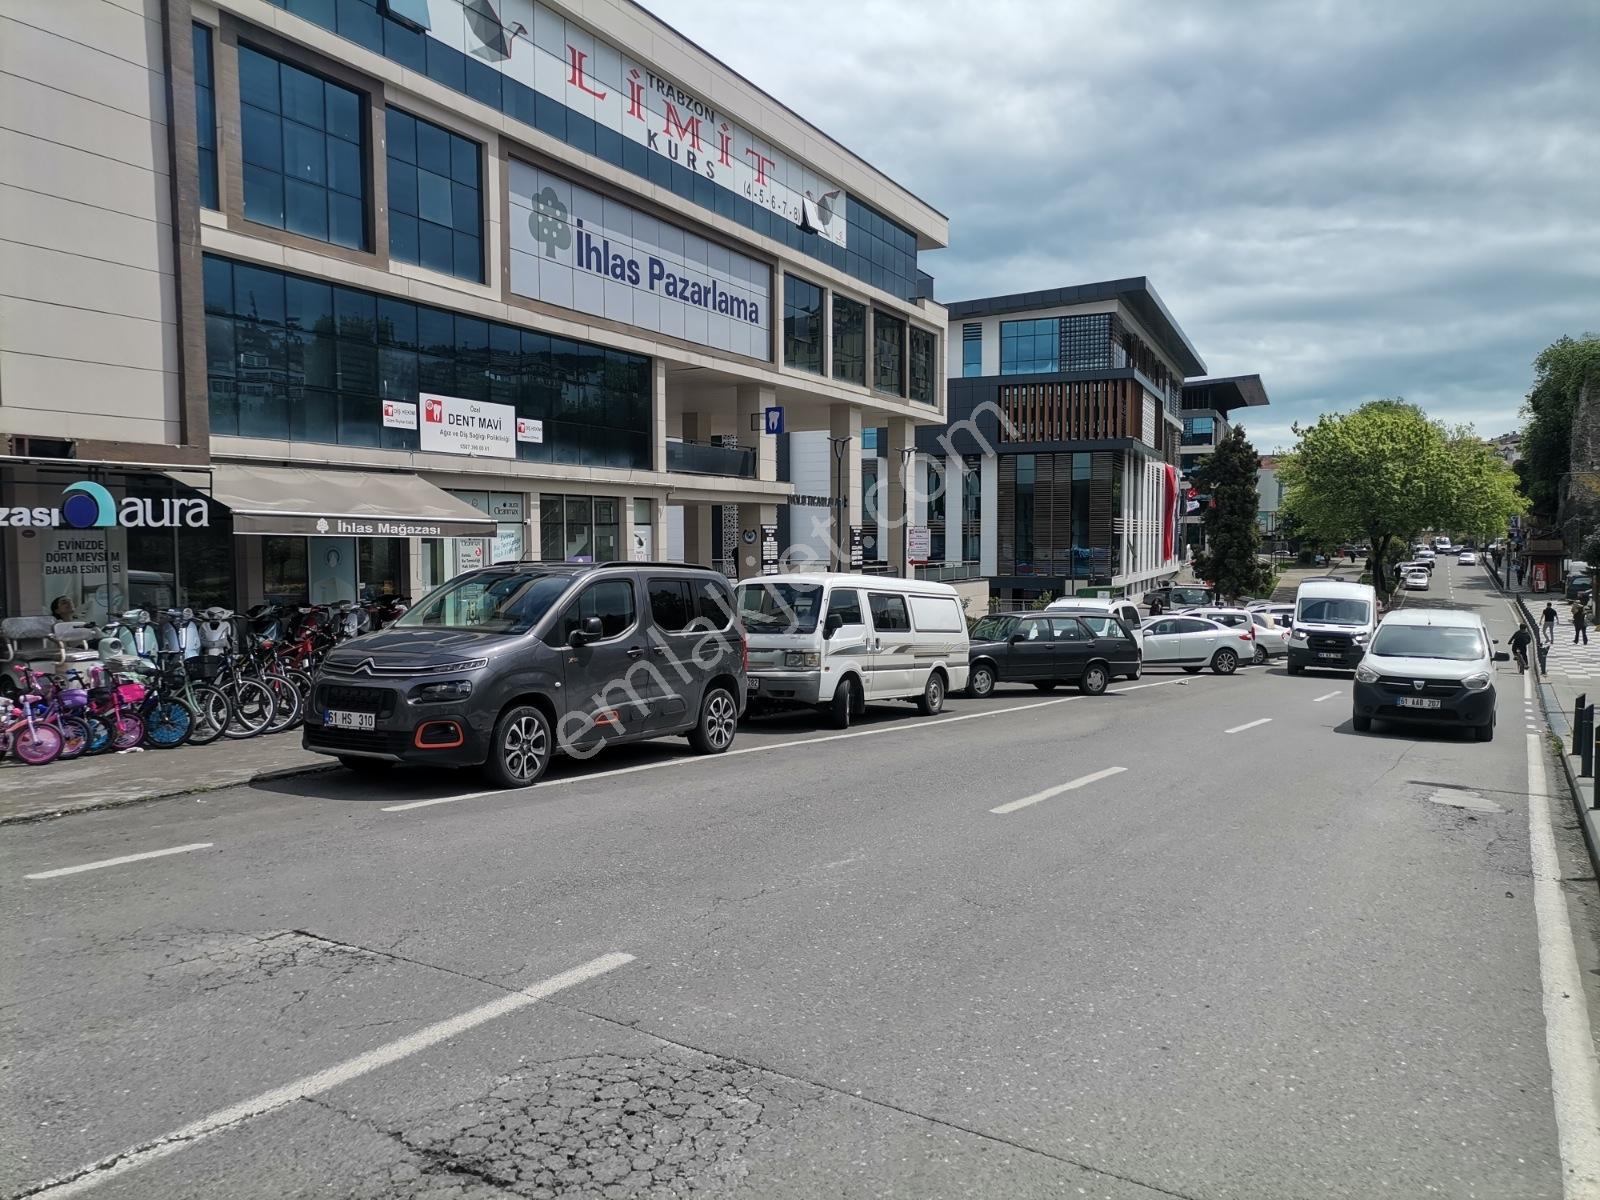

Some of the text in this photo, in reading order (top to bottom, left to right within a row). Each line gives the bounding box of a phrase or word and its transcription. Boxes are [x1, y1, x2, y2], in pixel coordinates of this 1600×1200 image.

[647, 72, 715, 124] TRABZON
[566, 44, 776, 187] LİMİT
[648, 129, 715, 179] KURS
[576, 218, 759, 324] İhlas Pazarlama
[469, 405, 481, 413] Özel
[448, 413, 503, 431] DENT MAVİ
[440, 428, 452, 438] Ağız
[460, 430, 468, 439] Diş
[118, 497, 209, 527] aura
[337, 519, 441, 536] İhlas Mağazası
[58, 537, 104, 550] EVİNİZDE
[46, 550, 73, 562] DÖRT
[45, 565, 78, 575] BAHAR
[329, 711, 374, 727] 61 HS 310
